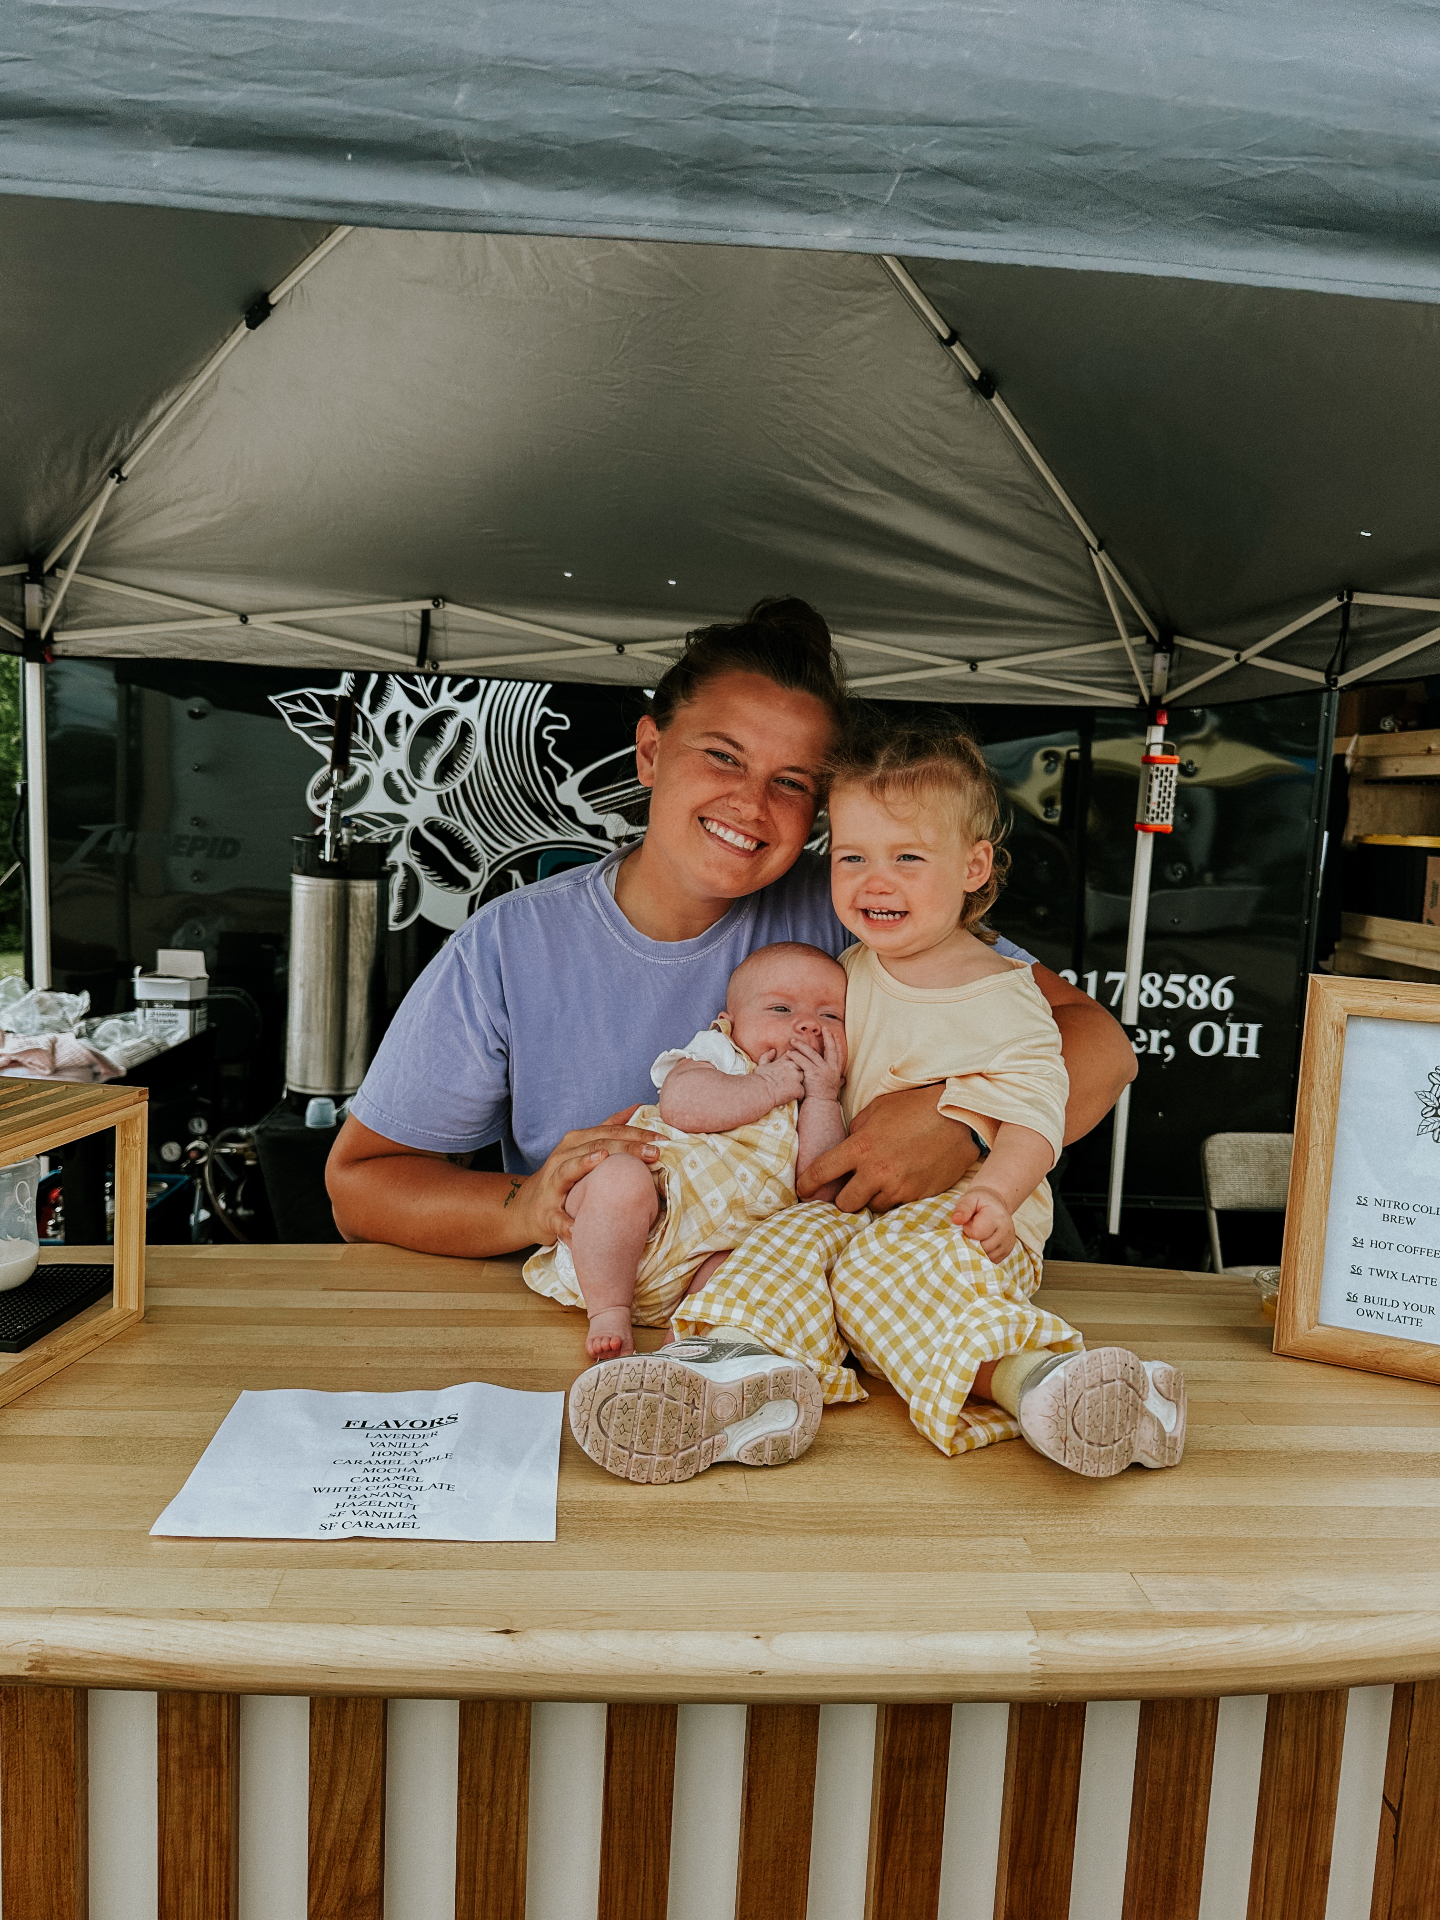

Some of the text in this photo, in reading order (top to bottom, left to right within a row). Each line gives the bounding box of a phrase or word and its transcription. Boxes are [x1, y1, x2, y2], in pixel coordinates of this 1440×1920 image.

[63, 823, 242, 867] INEPID
[1138, 972, 1236, 1011] 8586
[1188, 1021, 1263, 1058] OH
[1356, 1195, 1368, 1206] $5
[1373, 1198, 1410, 1211] NITRO
[1382, 1213, 1416, 1226] BREW
[1352, 1236, 1440, 1259] $4 HOT COFFEE
[1350, 1264, 1438, 1287] $6 TWIX LATTE
[1346, 1291, 1436, 1315] $6 BUILD YOUR
[1356, 1307, 1423, 1327] OWN LATTE
[342, 1412, 459, 1430] FLAVORS
[365, 1430, 439, 1440] LAVENDER
[369, 1441, 430, 1449] VANILLA
[409, 1452, 454, 1465] APPLE
[350, 1474, 424, 1483] CARAMEL
[312, 1482, 456, 1494] WHITE CHOCOLATE
[347, 1491, 413, 1500] BANANA
[334, 1500, 420, 1511] HAZELNUT
[327, 1509, 418, 1519] SF VANILLA
[318, 1520, 421, 1531] SF CARAMEL
